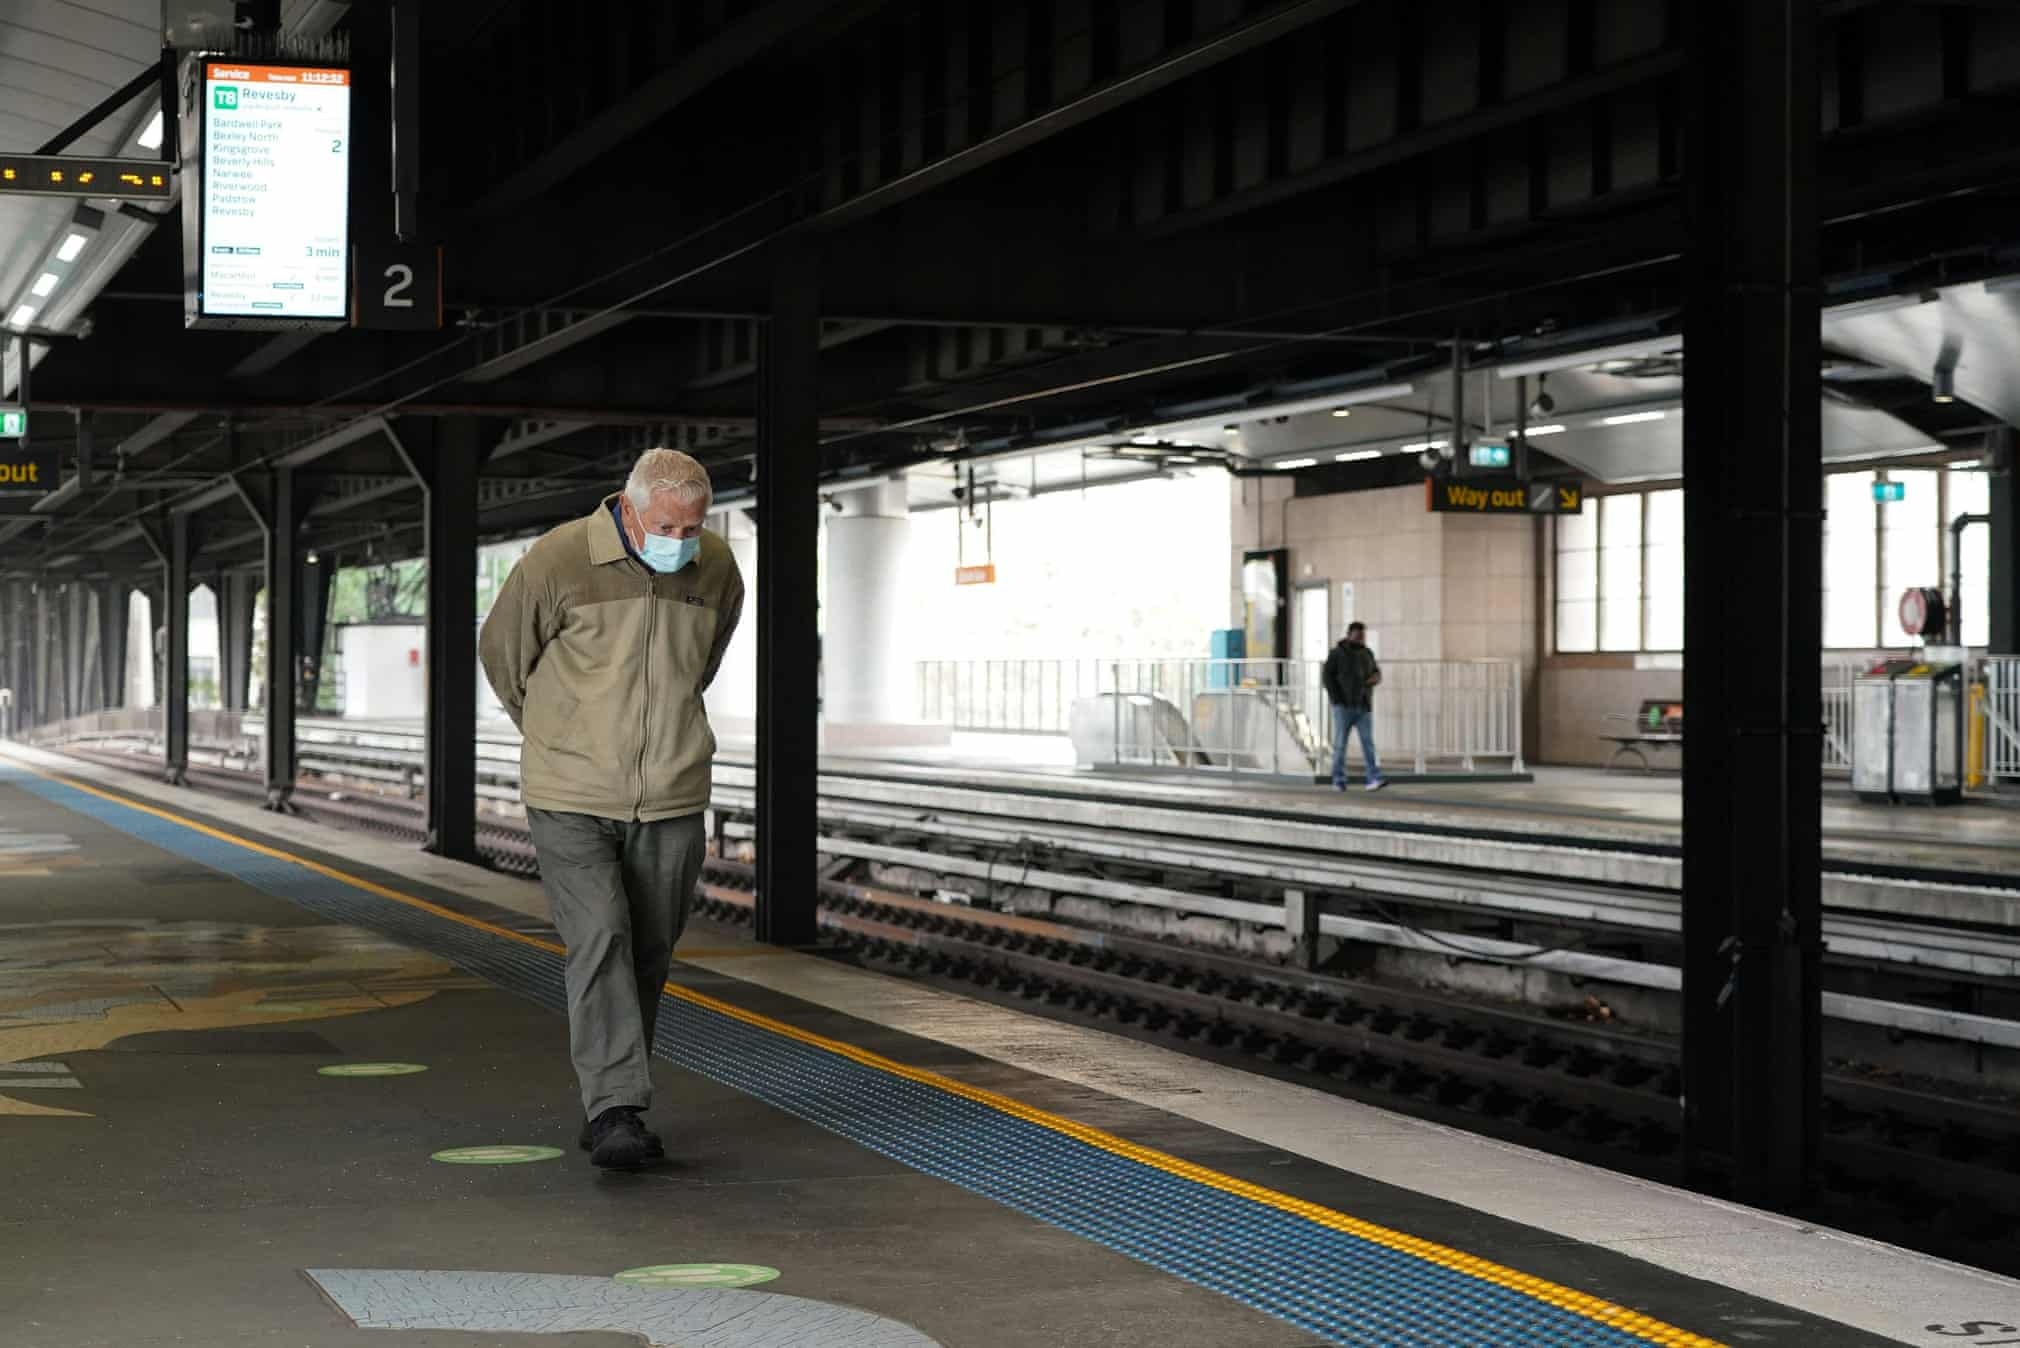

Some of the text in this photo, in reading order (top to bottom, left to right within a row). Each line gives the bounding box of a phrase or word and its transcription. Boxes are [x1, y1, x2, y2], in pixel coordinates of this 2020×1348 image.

[242, 88, 296, 102] Revesby
[213, 118, 283, 129] Bardwell Park
[213, 130, 280, 143] Bexley North
[213, 143, 271, 155] Kingsgrove
[331, 139, 342, 153] 2
[213, 155, 275, 168] Beverly Hills
[212, 180, 268, 192] Riverwood
[212, 193, 256, 204] Padstow
[212, 205, 255, 217] Revesby
[316, 247, 340, 257] min
[384, 264, 413, 307] 2
[0, 462, 38, 482] out
[1448, 486, 1525, 512] Way out
